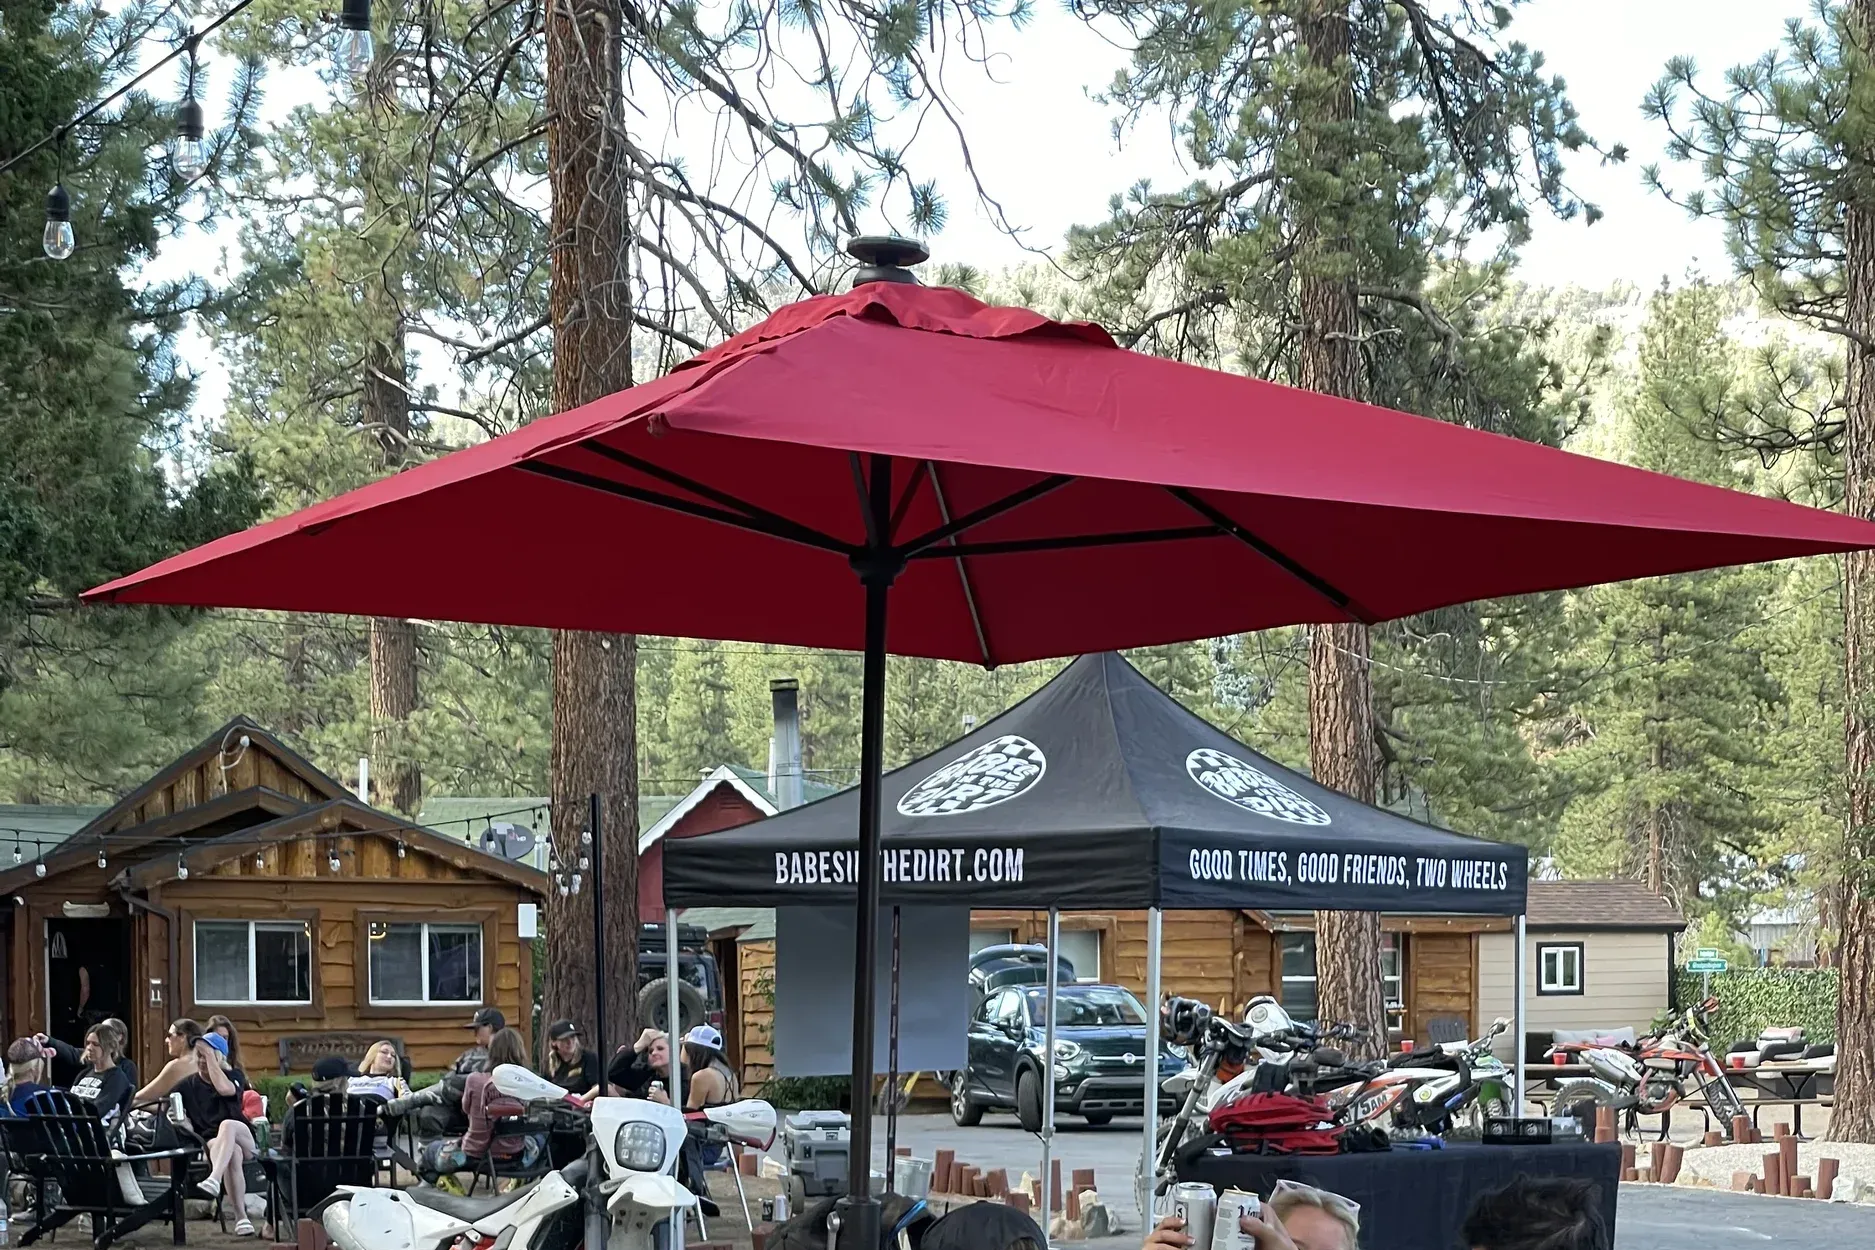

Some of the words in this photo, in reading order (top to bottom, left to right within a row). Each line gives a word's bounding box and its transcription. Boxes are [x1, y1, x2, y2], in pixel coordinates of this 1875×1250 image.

[909, 784, 1015, 803] DIRT
[1240, 796, 1317, 815] DIRT
[775, 848, 1024, 884] BABESIHEDIRT.COM
[1189, 849, 1233, 880] GOOD
[1238, 850, 1292, 886] TIMES,
[1297, 852, 1339, 884] GOOD
[1343, 853, 1410, 889] FRIENDS,
[1416, 857, 1447, 887] TWO
[1451, 859, 1507, 890] WHEELS
